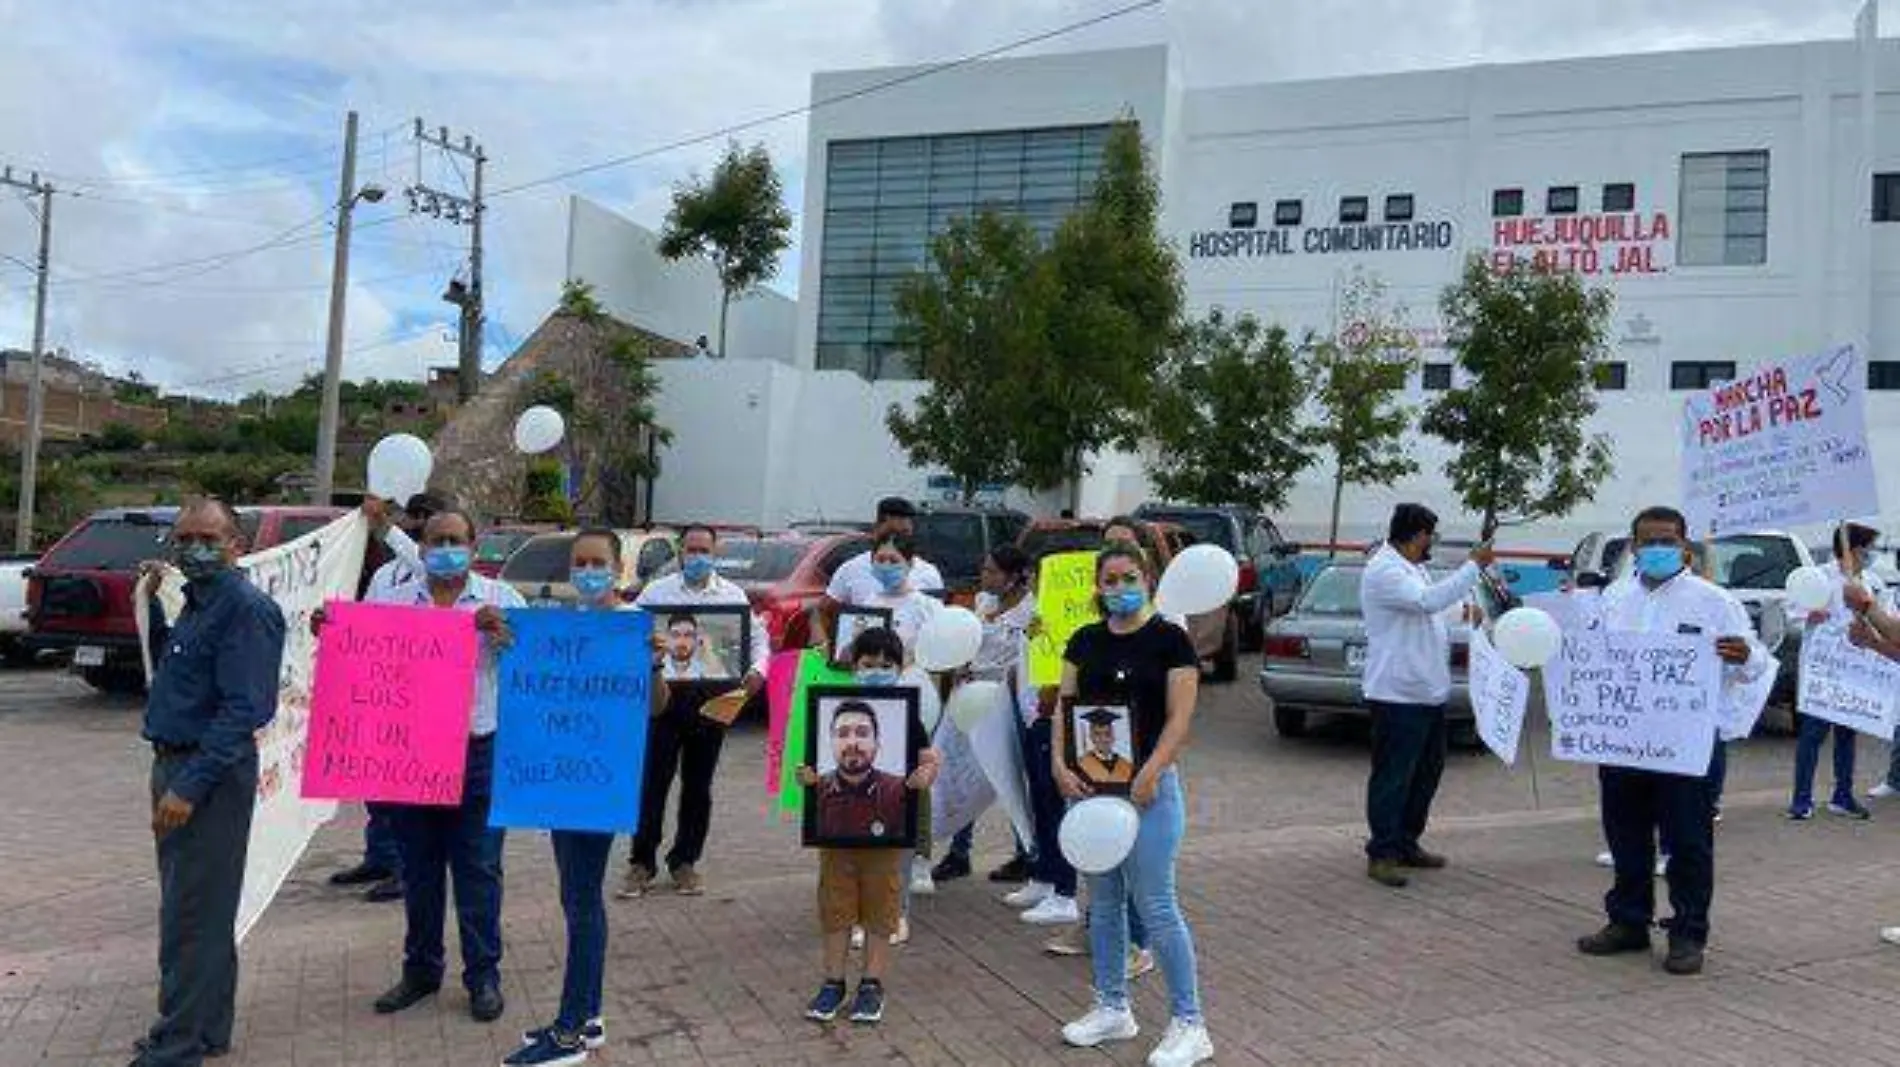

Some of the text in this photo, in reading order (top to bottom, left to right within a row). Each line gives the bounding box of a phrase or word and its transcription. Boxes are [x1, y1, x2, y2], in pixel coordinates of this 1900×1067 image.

[1190, 221, 1452, 258] HOSPITAL COMUNITARIO
[1494, 212, 1670, 248] HUEJUQUILLA
[1611, 246, 1668, 273] JAL.
[1735, 404, 1762, 436] LA
[1768, 388, 1822, 427] PAZ
[338, 627, 444, 660] JUSTICIA
[1561, 634, 1591, 664] No
[1605, 632, 1638, 669] hay
[1570, 667, 1612, 688] para
[351, 684, 411, 710] LUIS
[1560, 684, 1708, 712] la PAZ es el
[323, 714, 411, 751] NI UN
